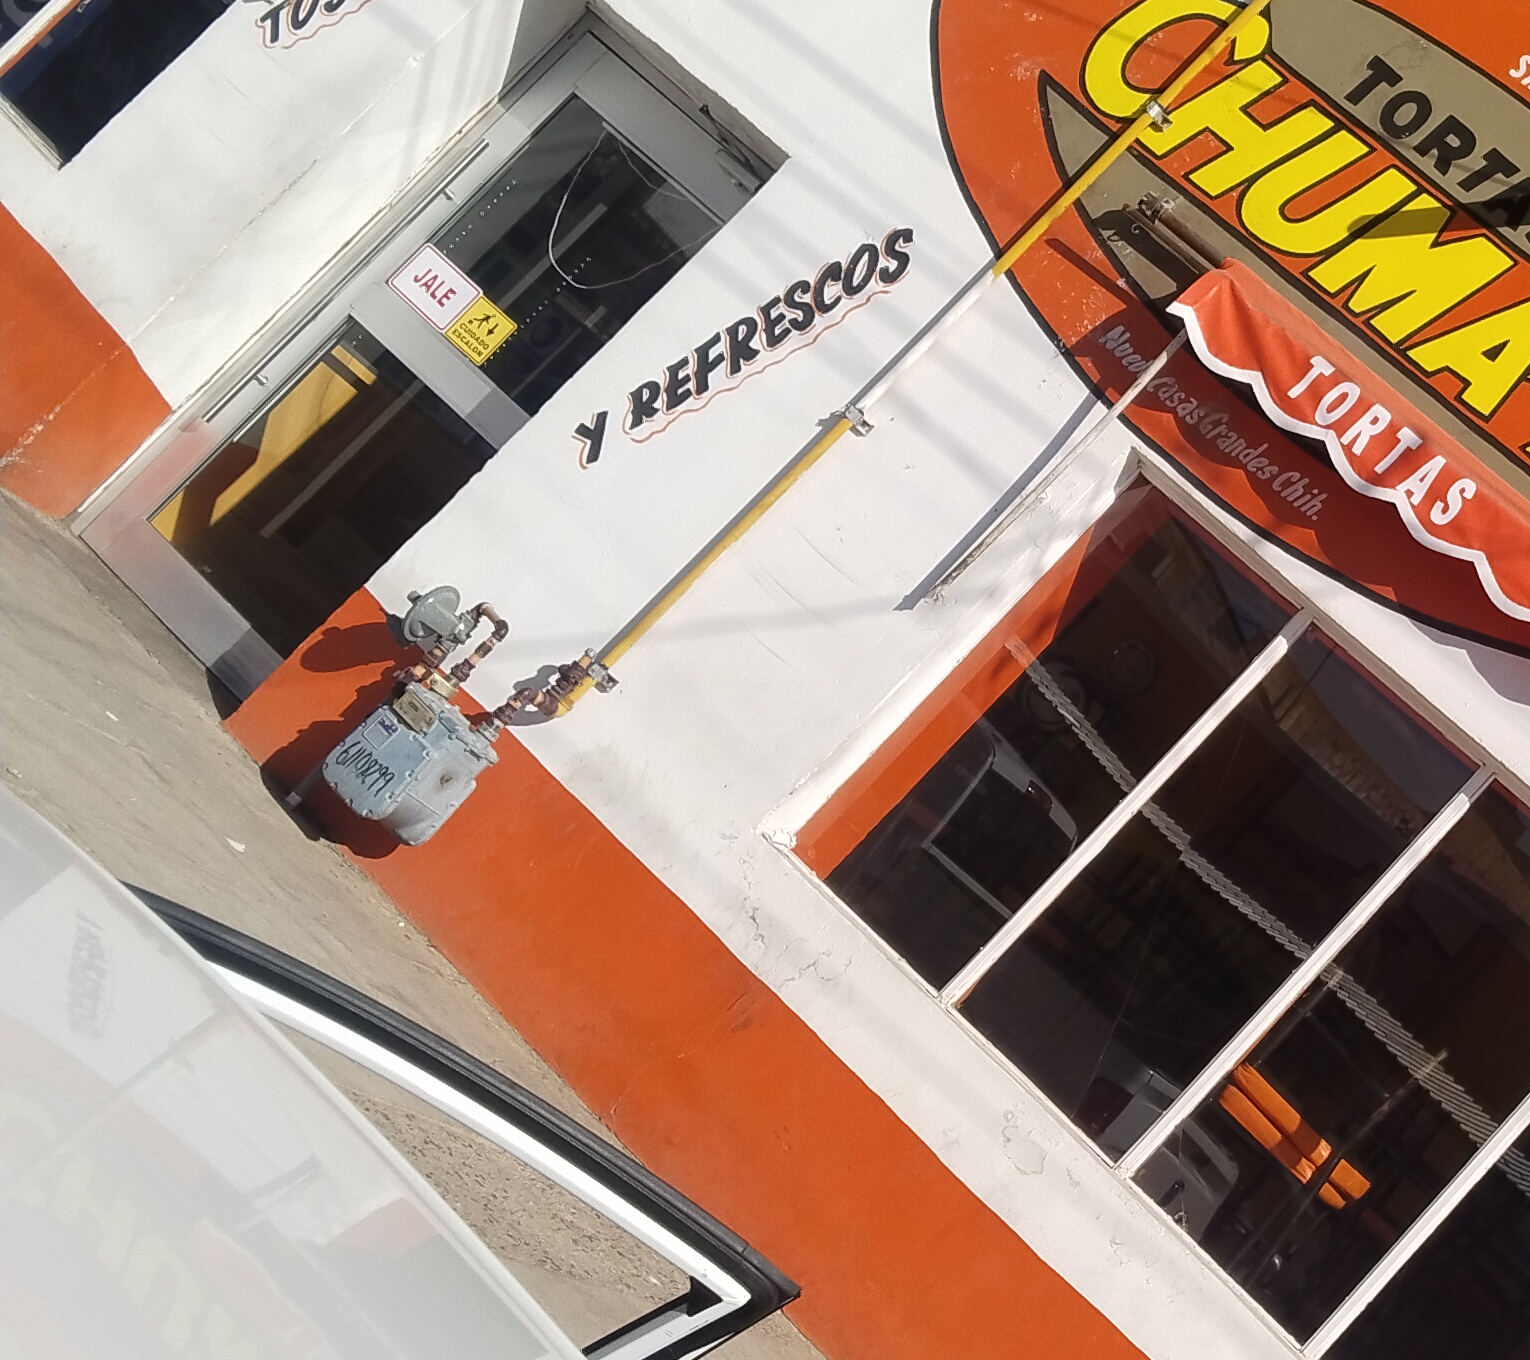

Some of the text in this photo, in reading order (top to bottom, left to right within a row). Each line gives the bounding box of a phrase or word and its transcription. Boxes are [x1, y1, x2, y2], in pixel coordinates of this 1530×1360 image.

[413, 268, 457, 307] JALE
[459, 322, 490, 351] CUIDADO
[572, 227, 915, 466] Y REFRESCOS
[1098, 324, 1328, 521] Nuev Casas Grandes Chih.
[1287, 354, 1478, 527] TORTAS
